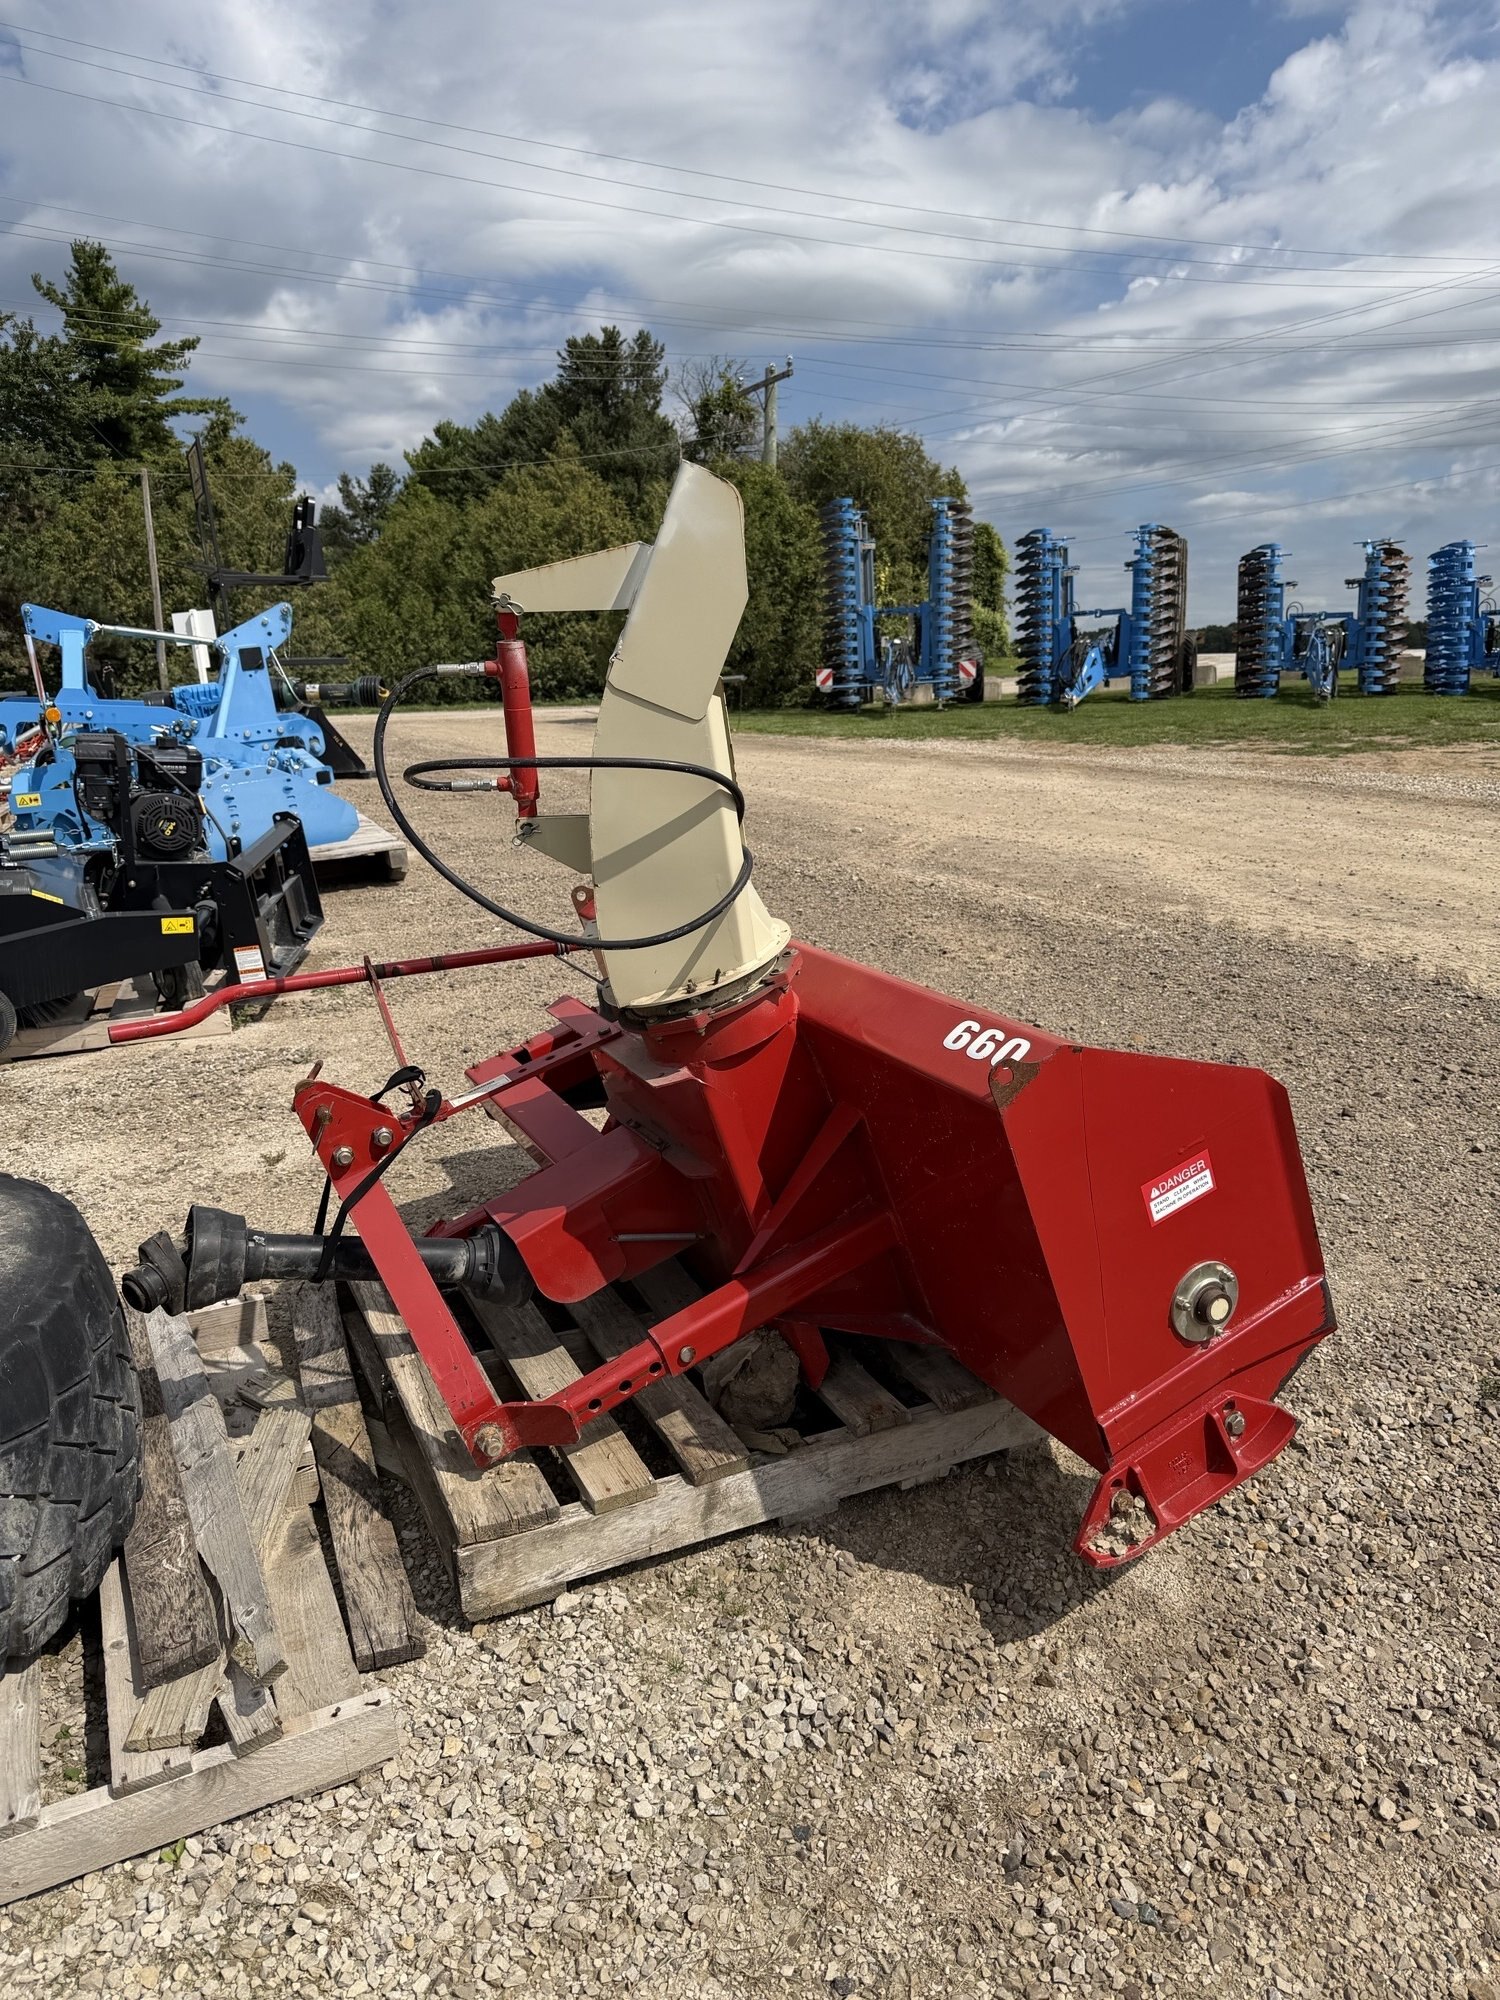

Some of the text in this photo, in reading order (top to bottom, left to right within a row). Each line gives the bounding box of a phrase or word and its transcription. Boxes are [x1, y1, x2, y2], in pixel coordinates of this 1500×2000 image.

[943, 1020, 1031, 1066] 660
[1153, 1174, 1208, 1208] STAND CLEAR WHEN
[1159, 1159, 1206, 1194] DANGER
[1155, 1200, 1176, 1215] MACHINE
[1182, 1180, 1209, 1199] OPERATION
